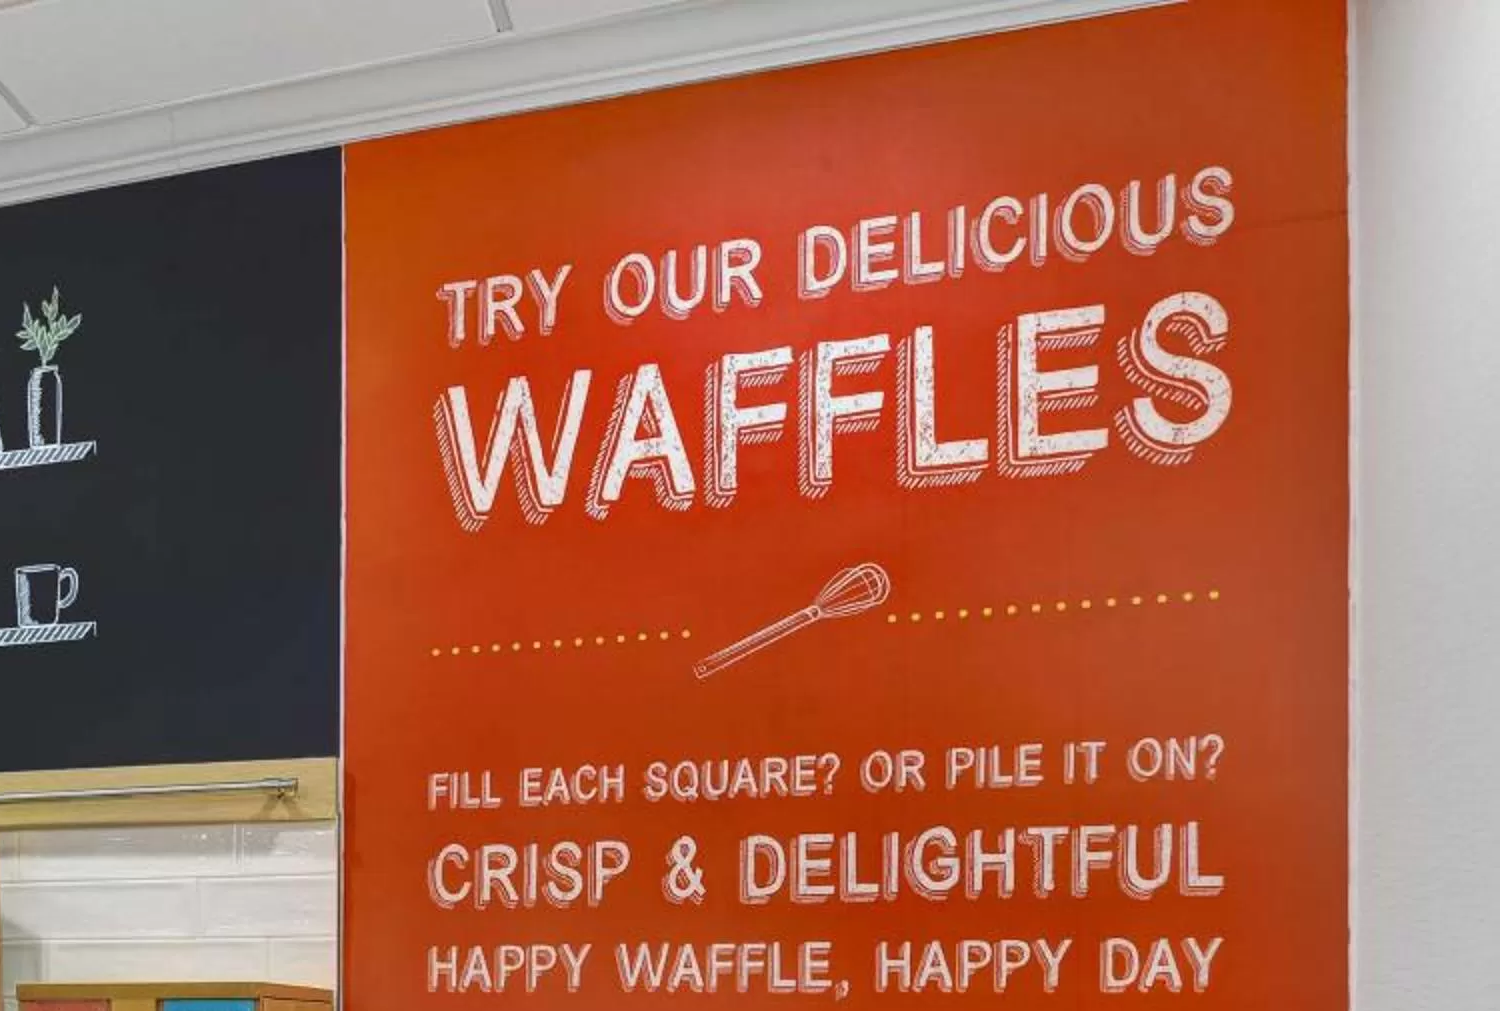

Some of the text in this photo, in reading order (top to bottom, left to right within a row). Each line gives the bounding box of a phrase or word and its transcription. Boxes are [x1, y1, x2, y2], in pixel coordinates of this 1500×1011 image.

[437, 165, 1236, 345] TRY OUR DELICIOUS
[434, 291, 1234, 532] WAFFLES
[428, 734, 1226, 811] FILL EACH SQUARE? OR PILE IT ON?
[428, 822, 1226, 910] CRISP & DELIGHTFUL
[428, 937, 1224, 1000] HAPPY WAFFLE, HAPPY DAY
